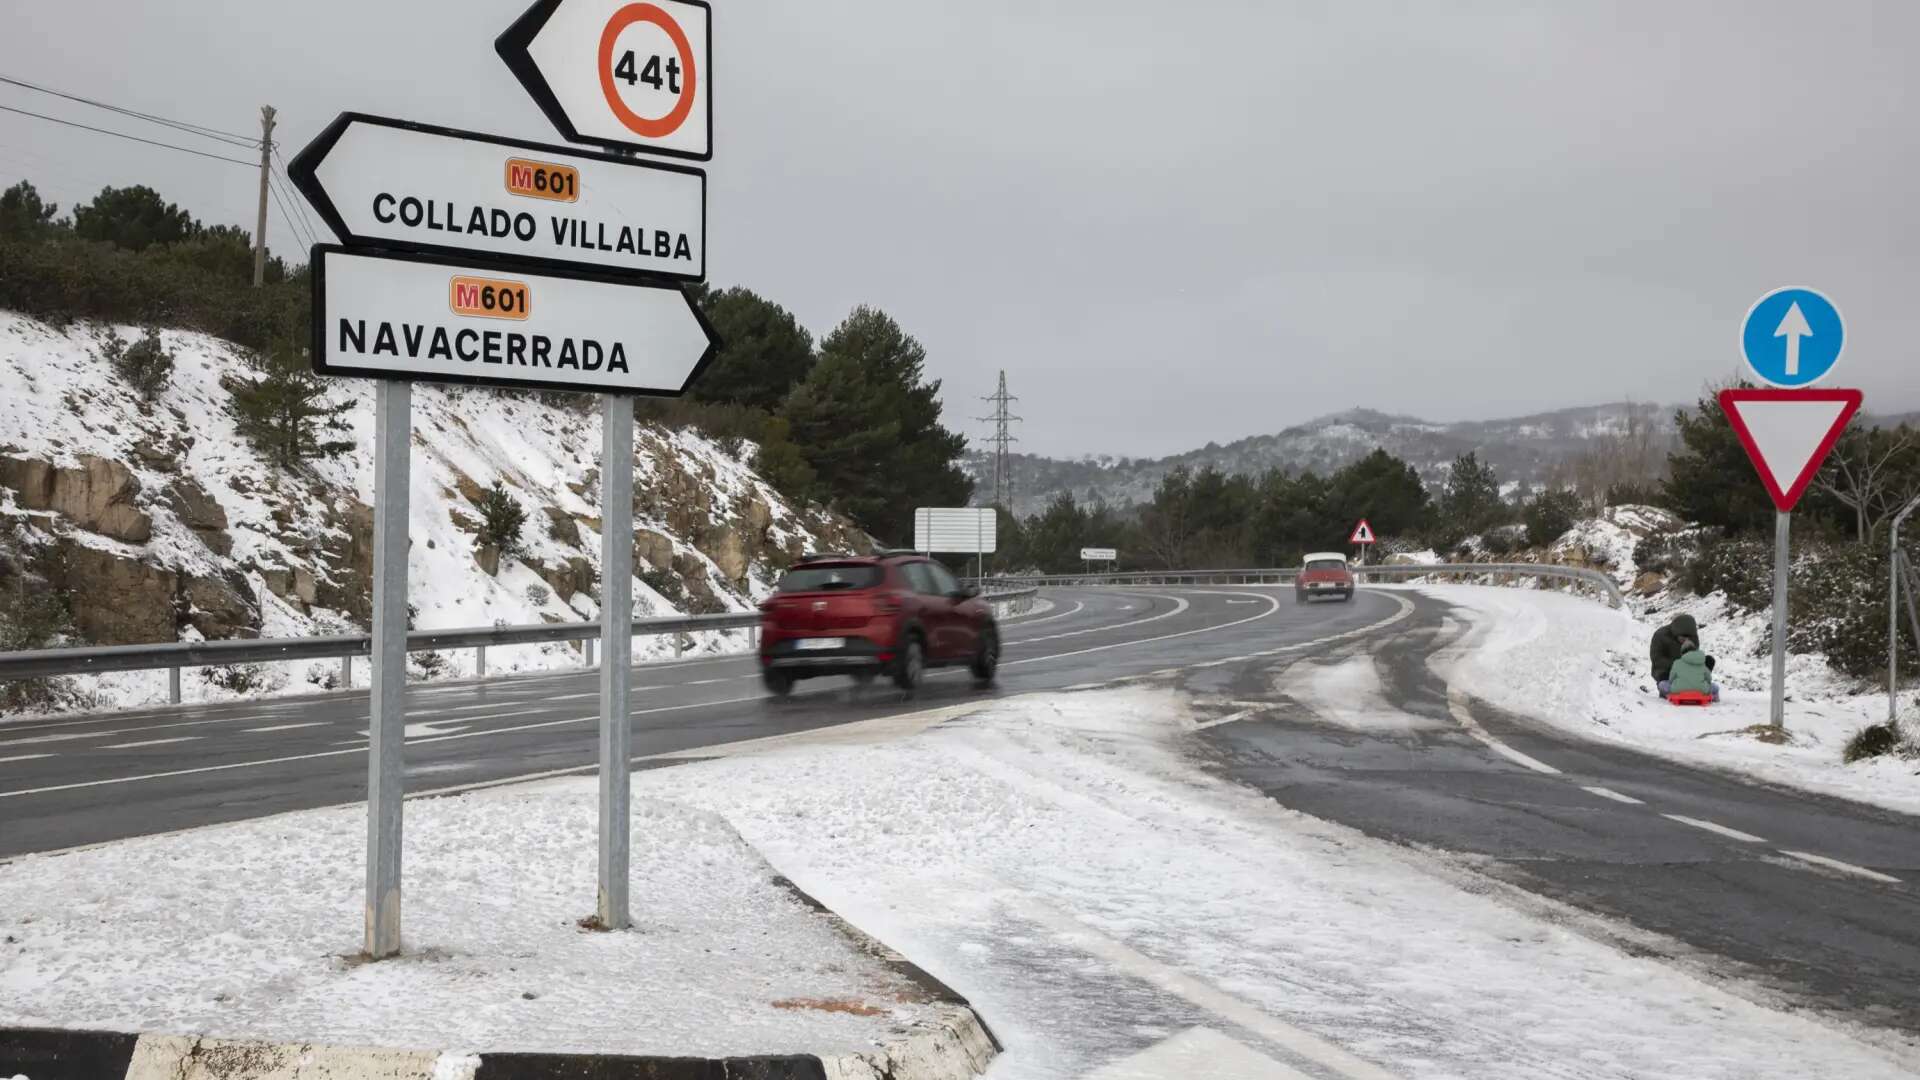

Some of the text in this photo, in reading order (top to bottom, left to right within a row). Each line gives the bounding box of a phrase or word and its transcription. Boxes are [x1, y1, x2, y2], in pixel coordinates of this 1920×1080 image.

[614, 50, 681, 95] 44t
[511, 165, 575, 197] M601
[372, 192, 693, 262] COLLADO VILLALBA
[456, 283, 526, 313] M601
[338, 318, 630, 374] NAVACERRADA
